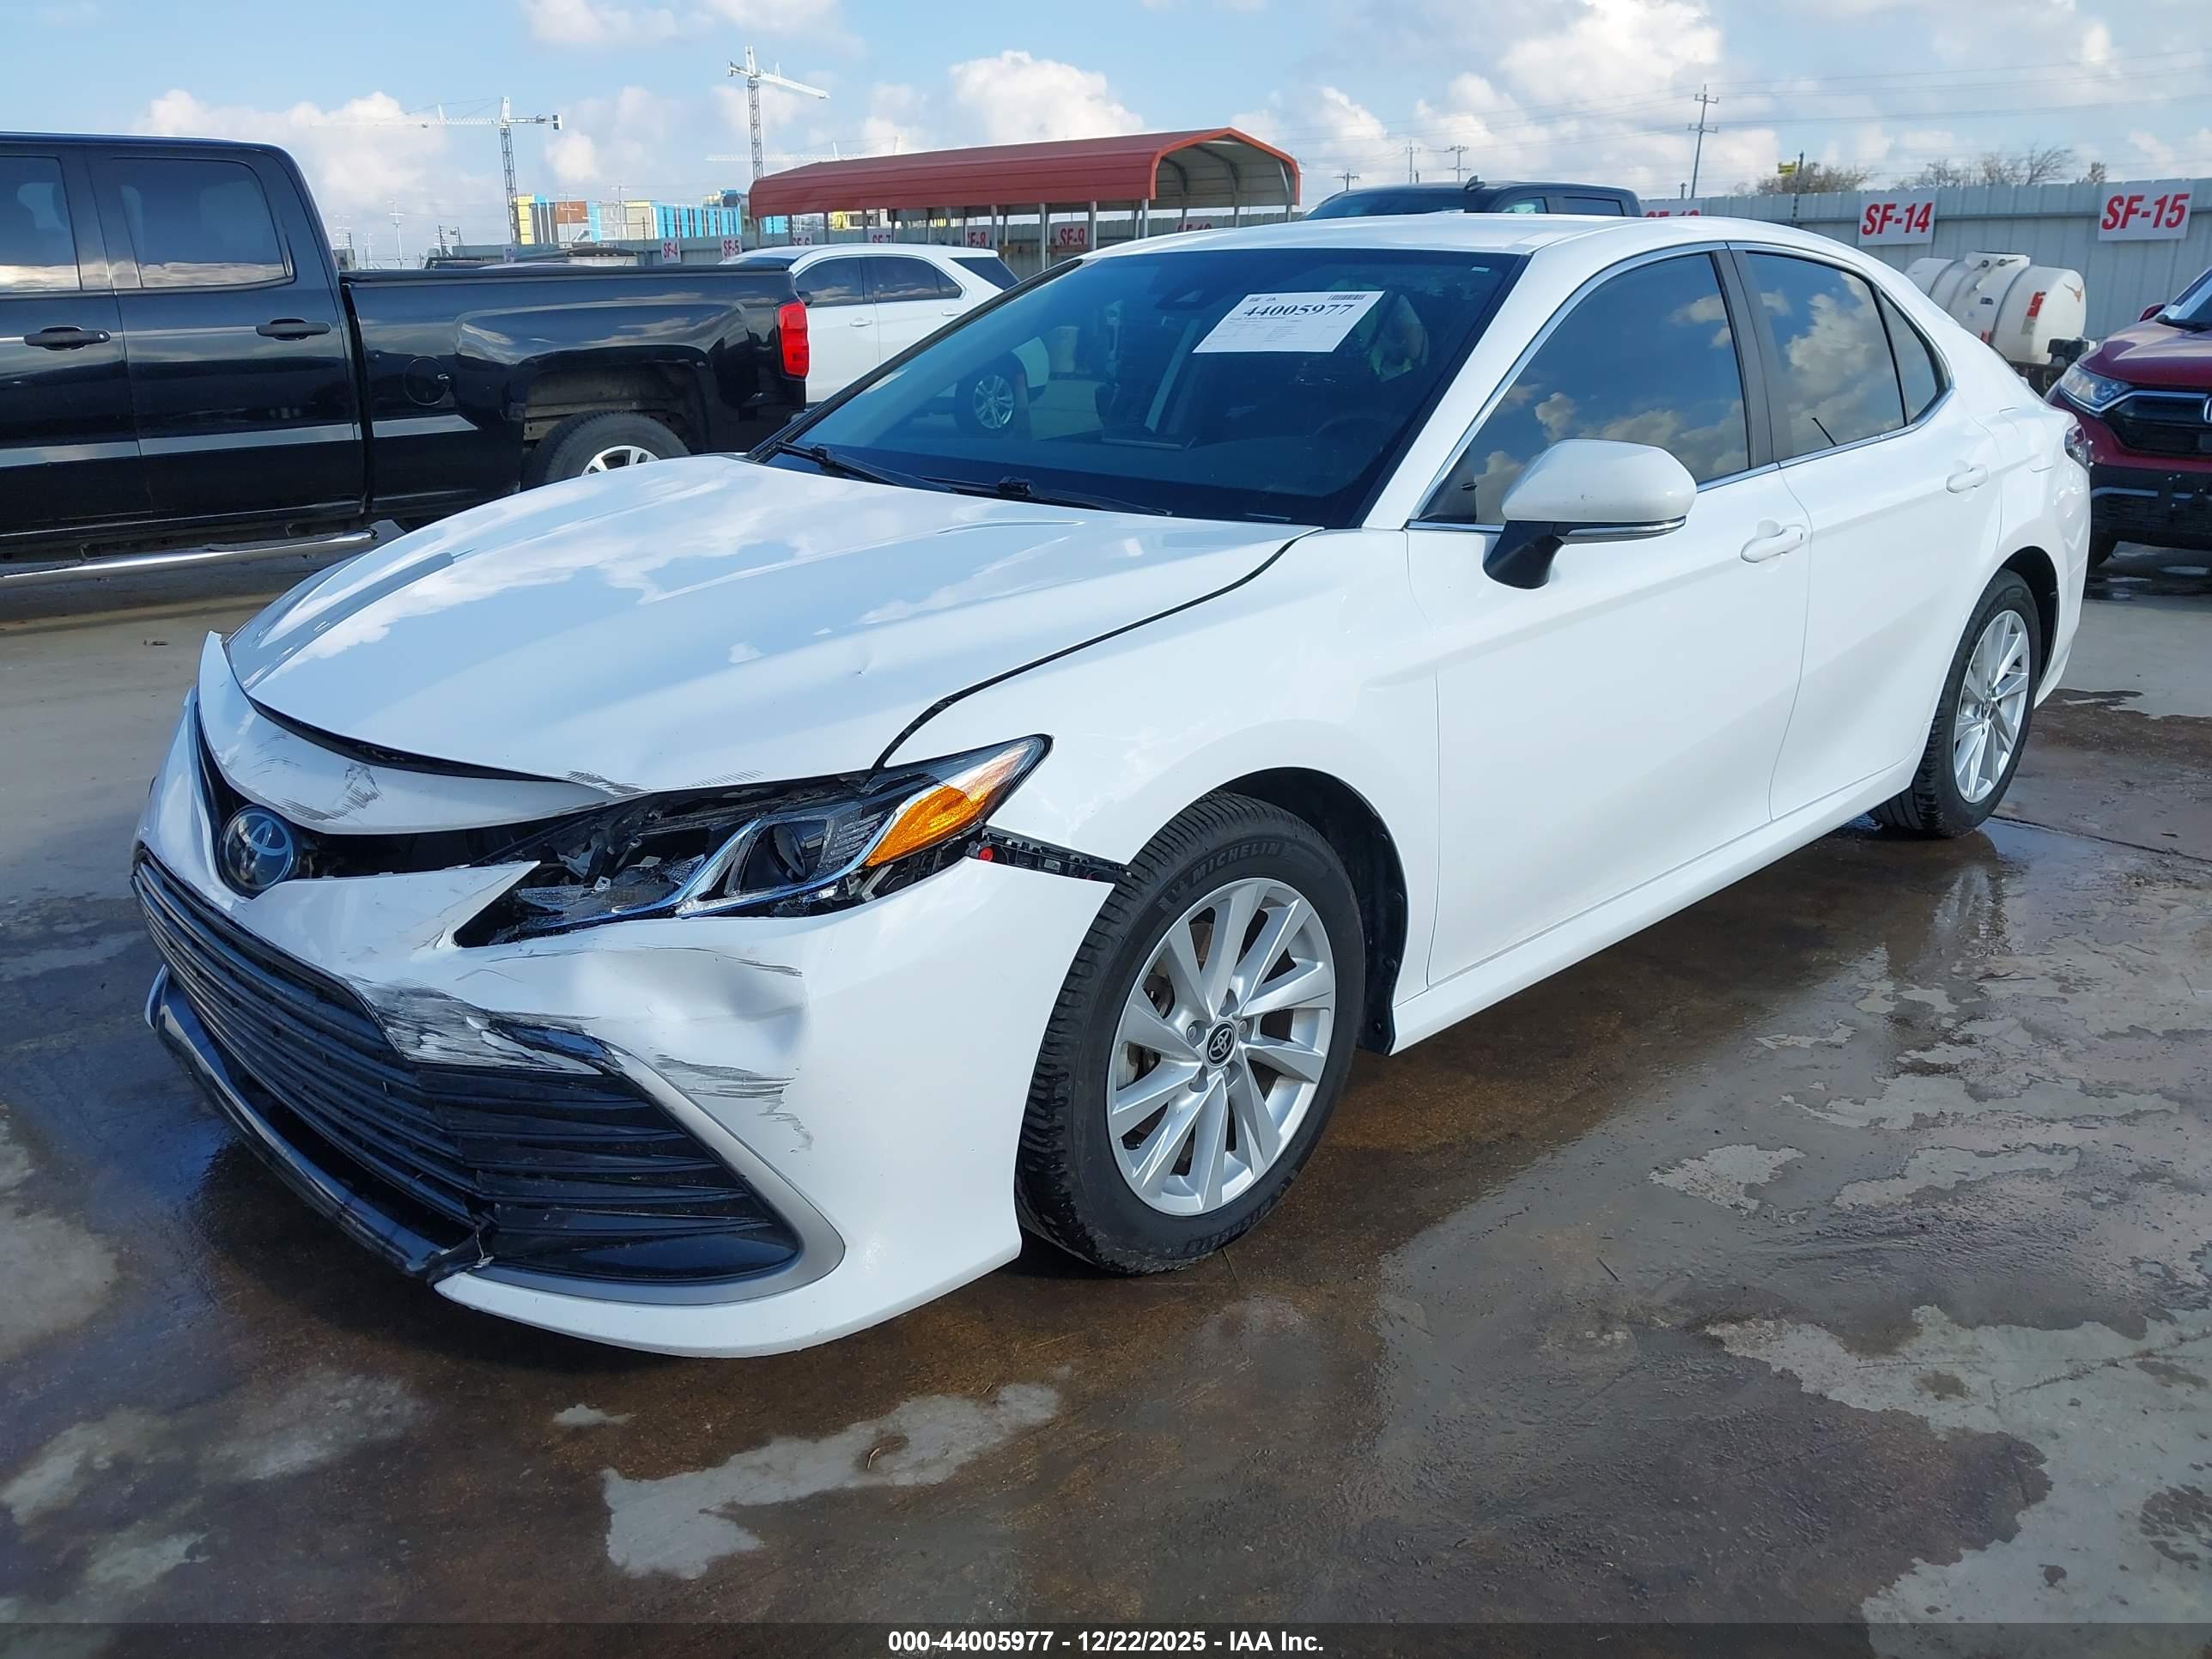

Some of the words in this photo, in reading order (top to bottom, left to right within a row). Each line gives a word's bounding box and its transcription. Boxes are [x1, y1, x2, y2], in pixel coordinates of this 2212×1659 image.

[1861, 202, 1934, 236] SF-14
[2101, 193, 2191, 230] SF-15
[1060, 228, 1085, 246] SF-9
[663, 242, 678, 258] SF-4
[723, 240, 739, 258] SF-5
[1243, 303, 1356, 317] 44005977
[1191, 842, 1280, 884] MICHELIN
